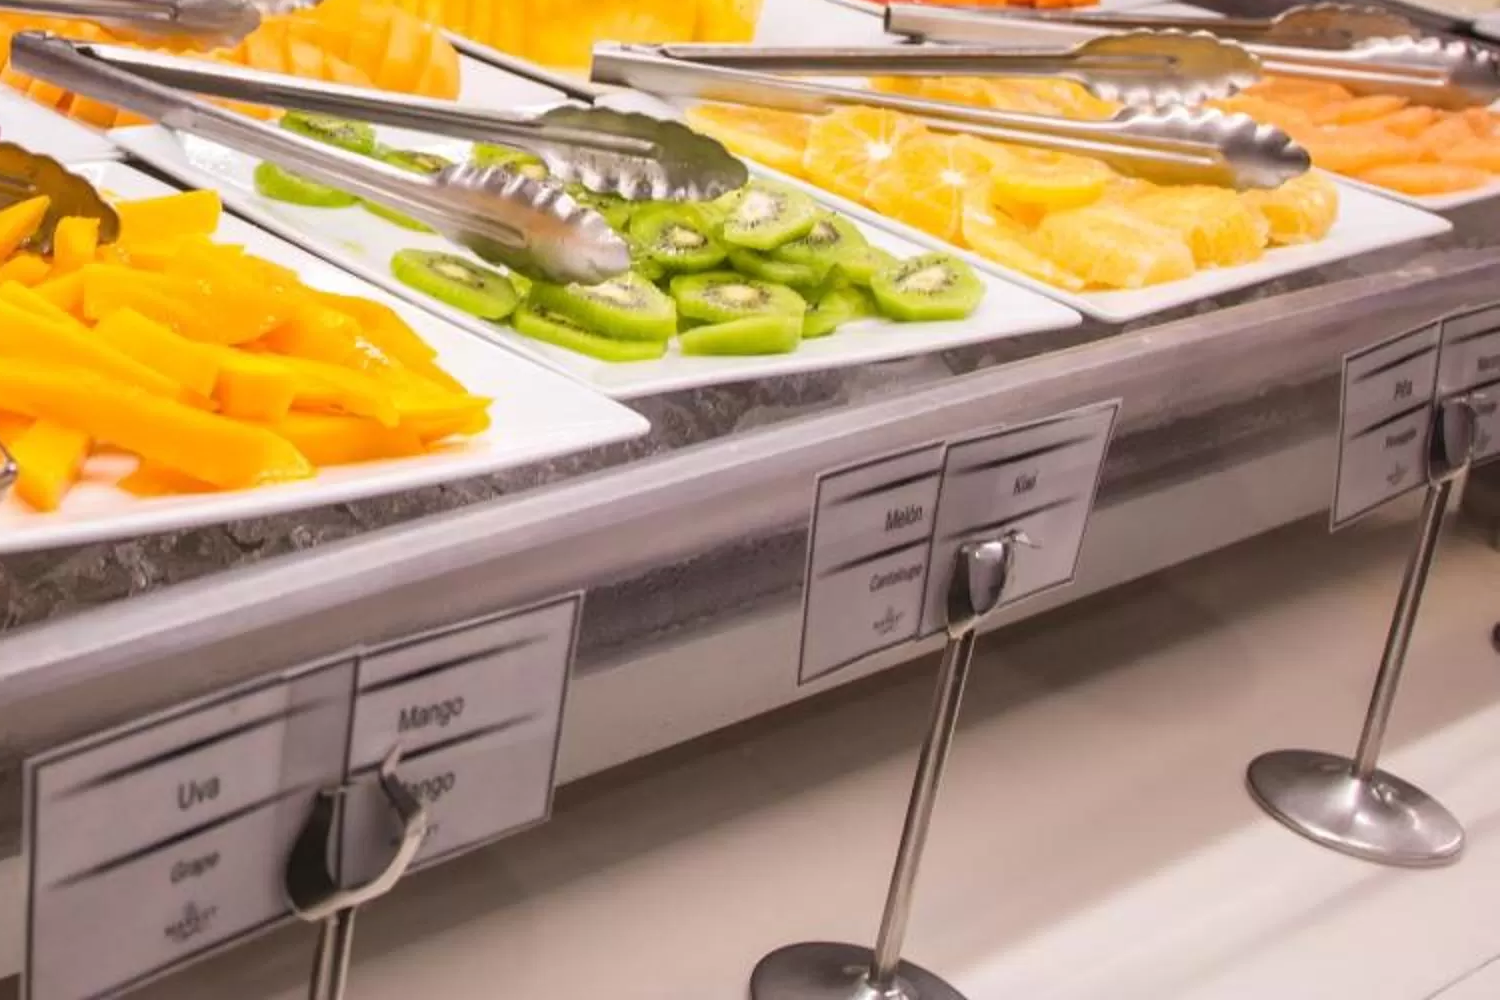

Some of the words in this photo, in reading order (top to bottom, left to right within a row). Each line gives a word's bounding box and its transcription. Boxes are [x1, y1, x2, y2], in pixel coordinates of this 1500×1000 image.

[397, 695, 465, 734] Mango
[176, 775, 220, 812] Uva
[402, 771, 456, 803] ango
